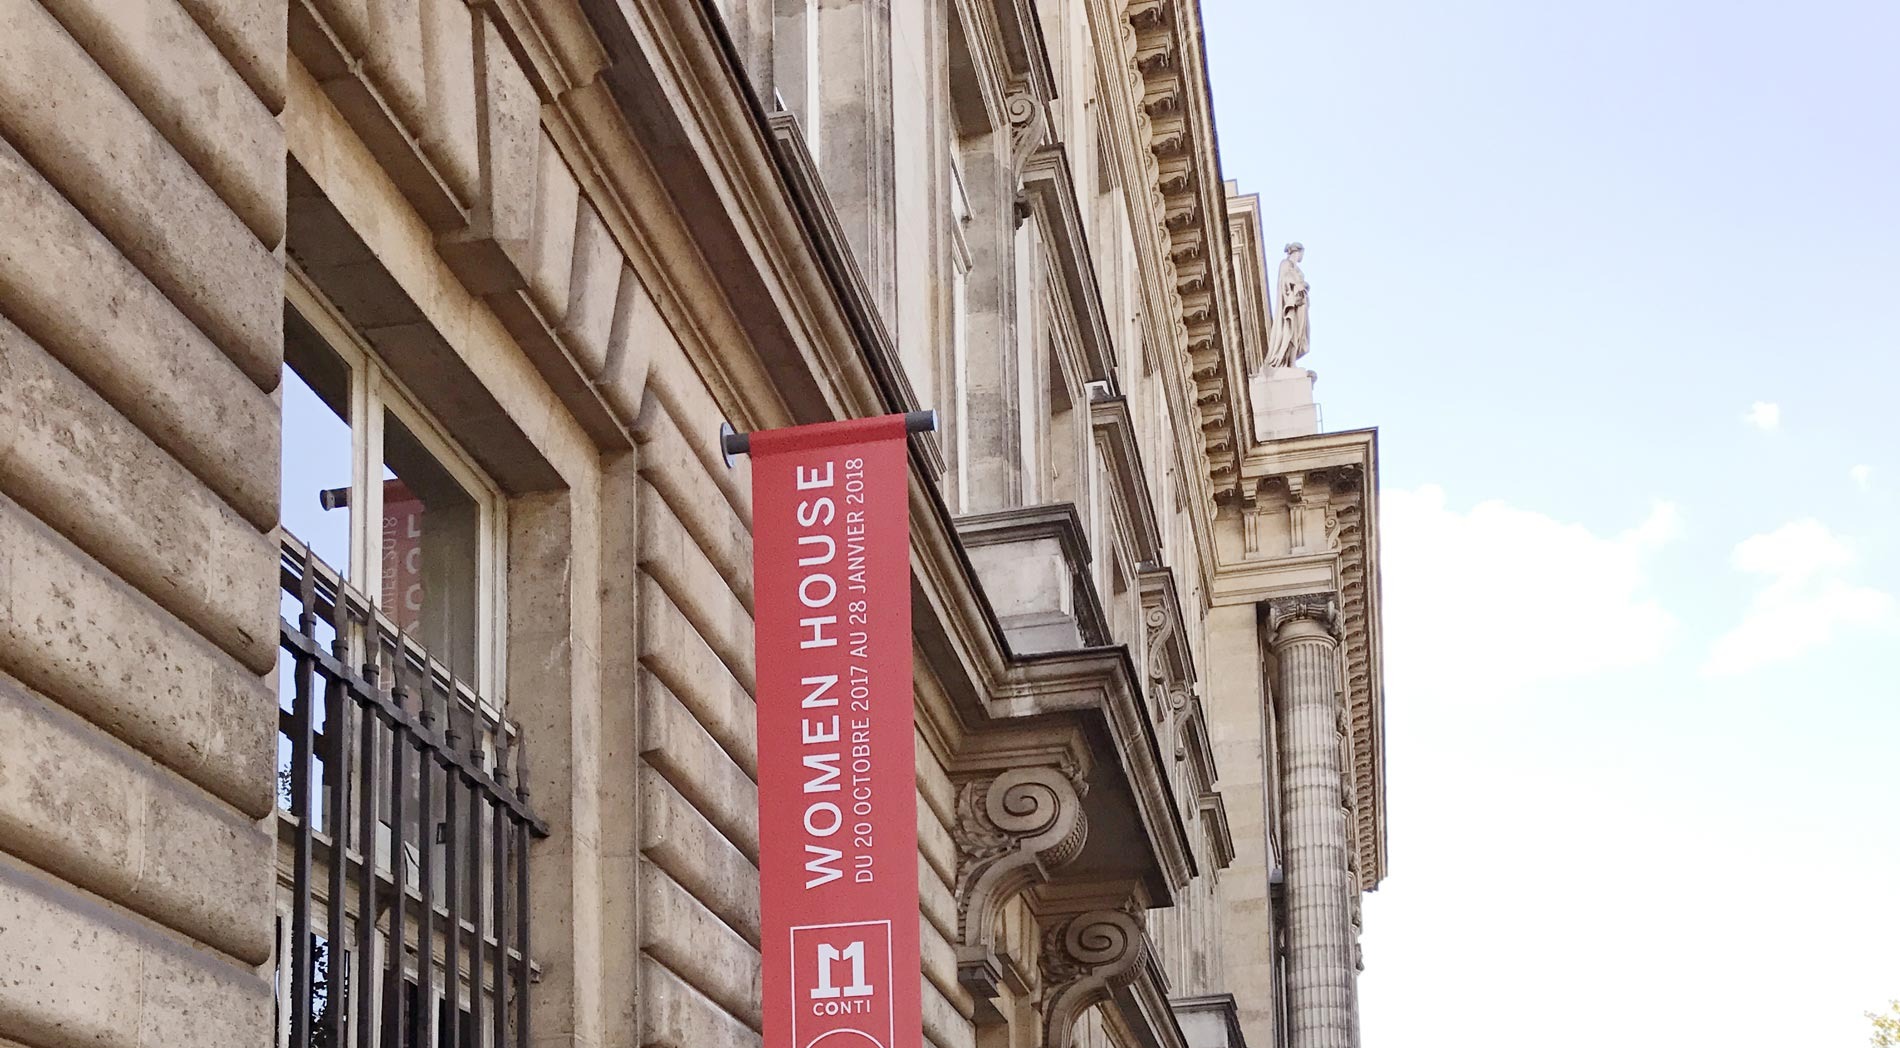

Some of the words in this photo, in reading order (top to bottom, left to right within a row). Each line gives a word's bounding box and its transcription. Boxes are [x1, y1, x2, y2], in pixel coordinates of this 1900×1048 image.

[845, 457, 864, 505] 2018
[796, 461, 839, 649] HOUSE
[846, 510, 867, 594] JANVIER
[848, 600, 867, 625] 28
[849, 631, 868, 658] AU
[850, 665, 869, 712] 2017
[801, 675, 844, 890] WOMEN
[851, 717, 872, 814] OCTOBRE
[854, 822, 873, 848] 20
[855, 855, 874, 883] DU
[813, 1000, 871, 1016] CONTI
